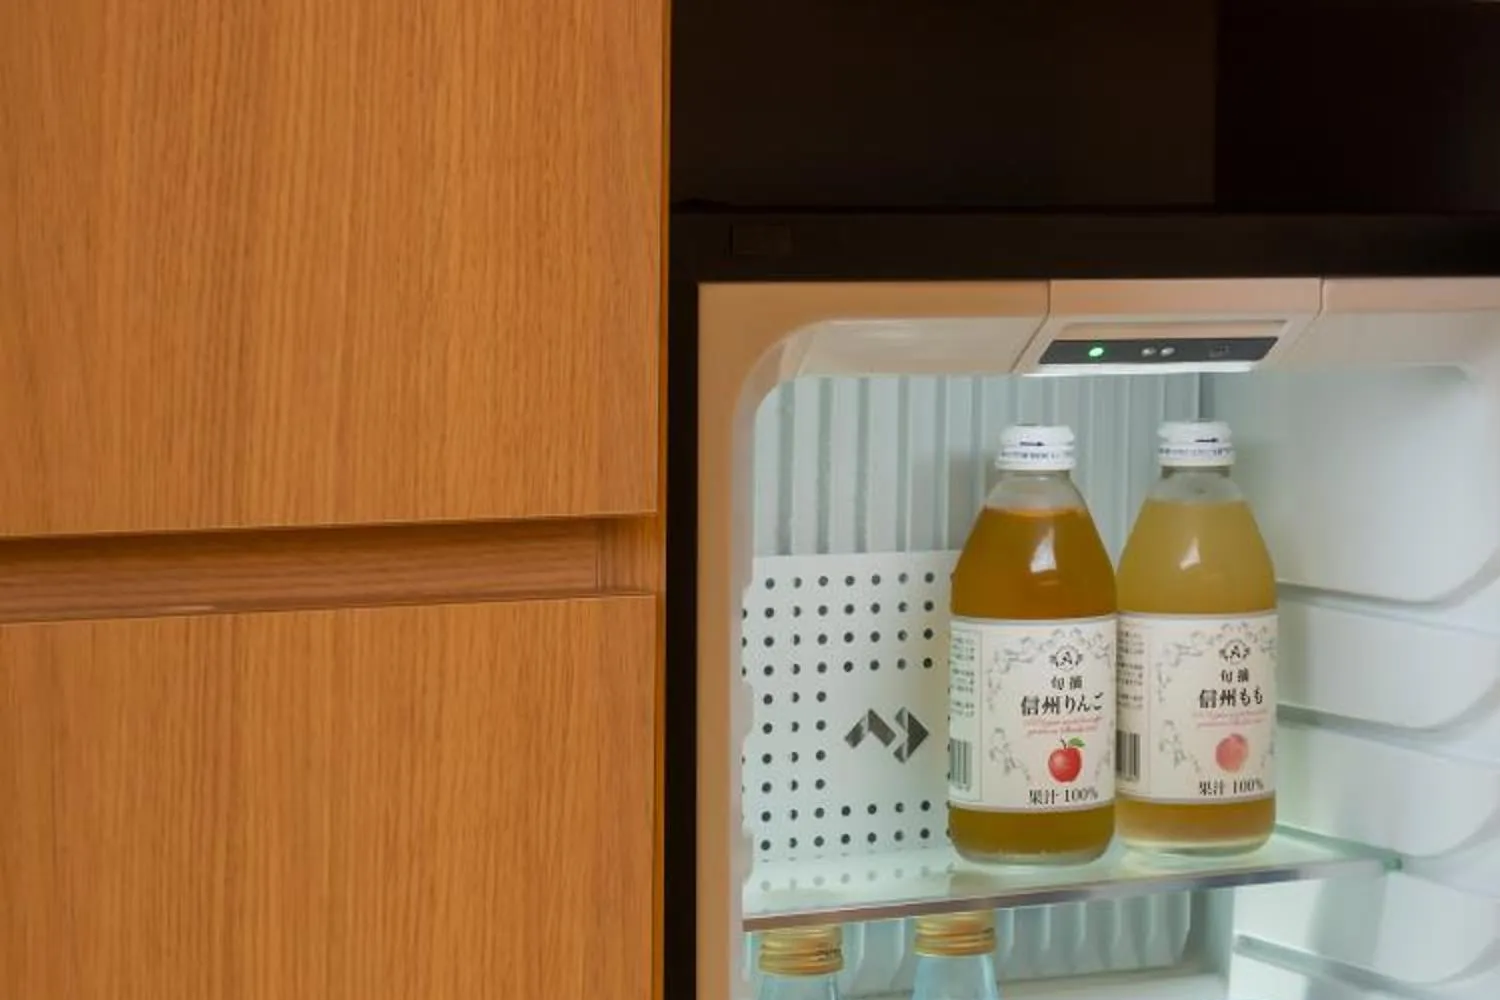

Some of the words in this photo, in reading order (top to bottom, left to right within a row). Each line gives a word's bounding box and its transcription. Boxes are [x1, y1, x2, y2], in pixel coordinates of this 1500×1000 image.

[1021, 691, 1104, 717] 信州りんご
[1199, 686, 1263, 708] 信州もも
[1028, 788, 1059, 805] 果汁
[1064, 786, 1099, 803] 100%
[1232, 777, 1265, 794] 100%
